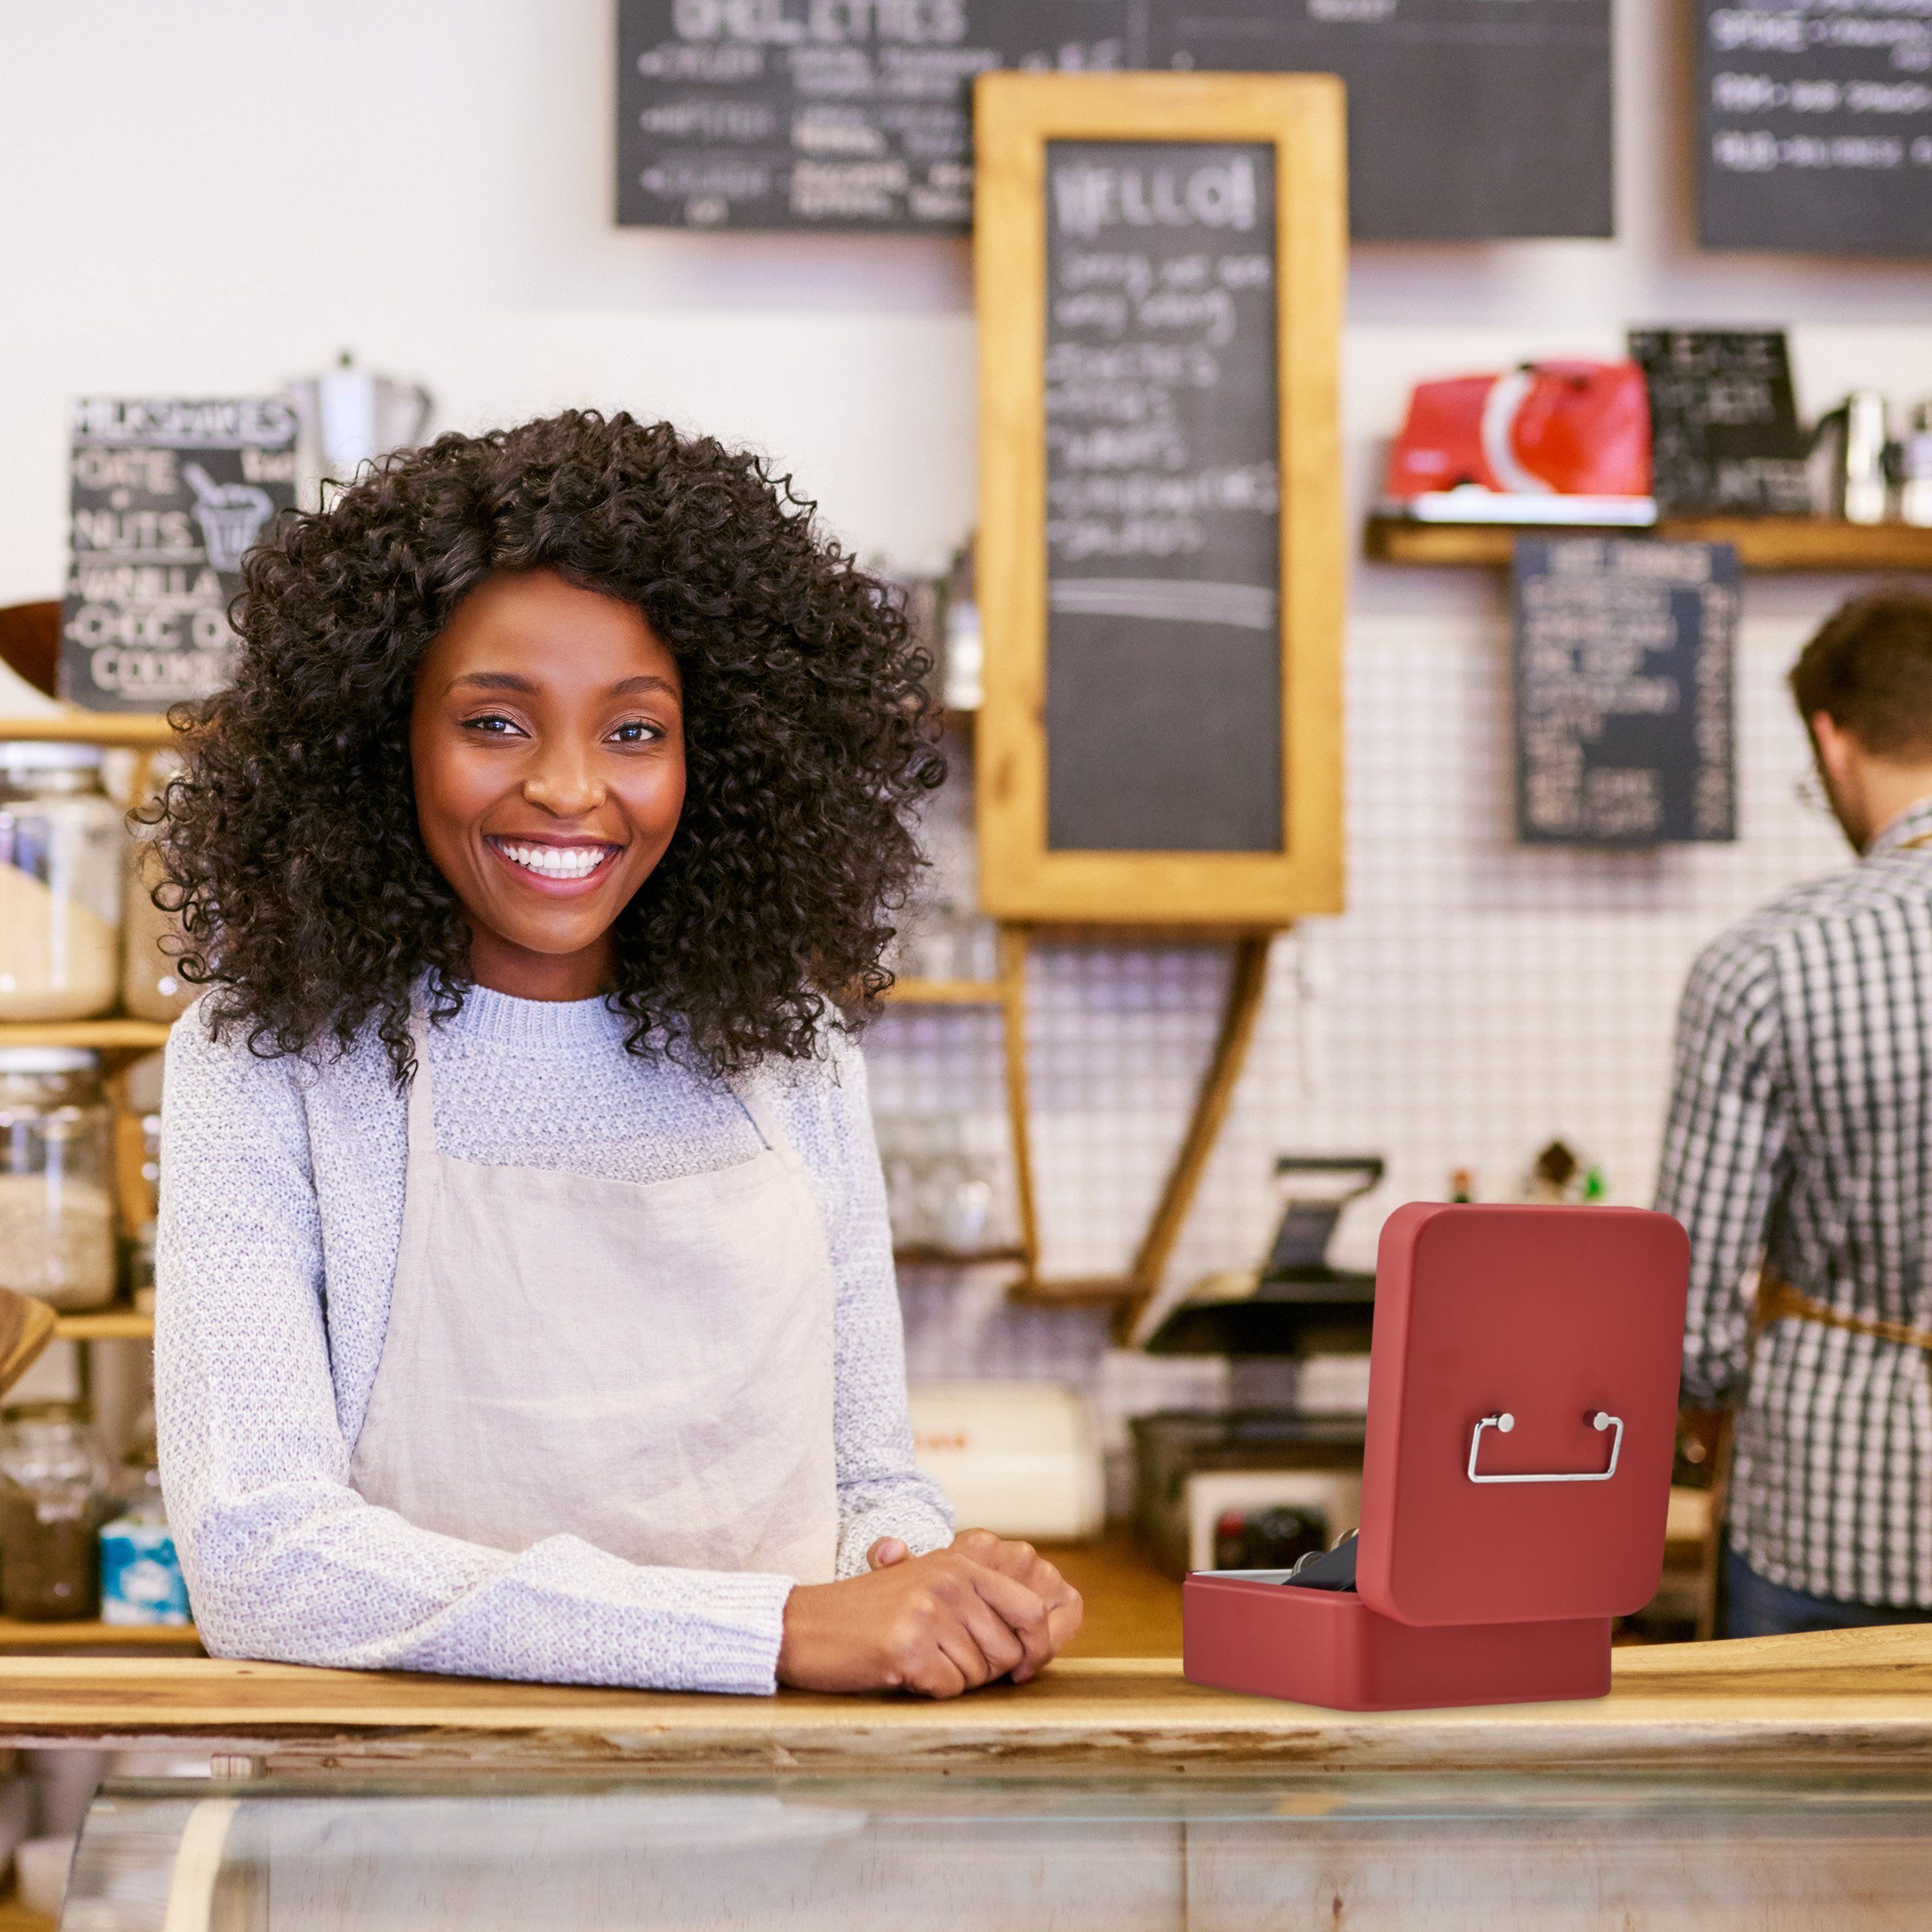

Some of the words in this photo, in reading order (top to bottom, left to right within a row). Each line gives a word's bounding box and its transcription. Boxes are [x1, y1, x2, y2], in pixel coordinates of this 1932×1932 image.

[73, 401, 295, 441] MILKSHAKES
[76, 509, 193, 549] NUTS
[82, 565, 224, 604] VANILLA
